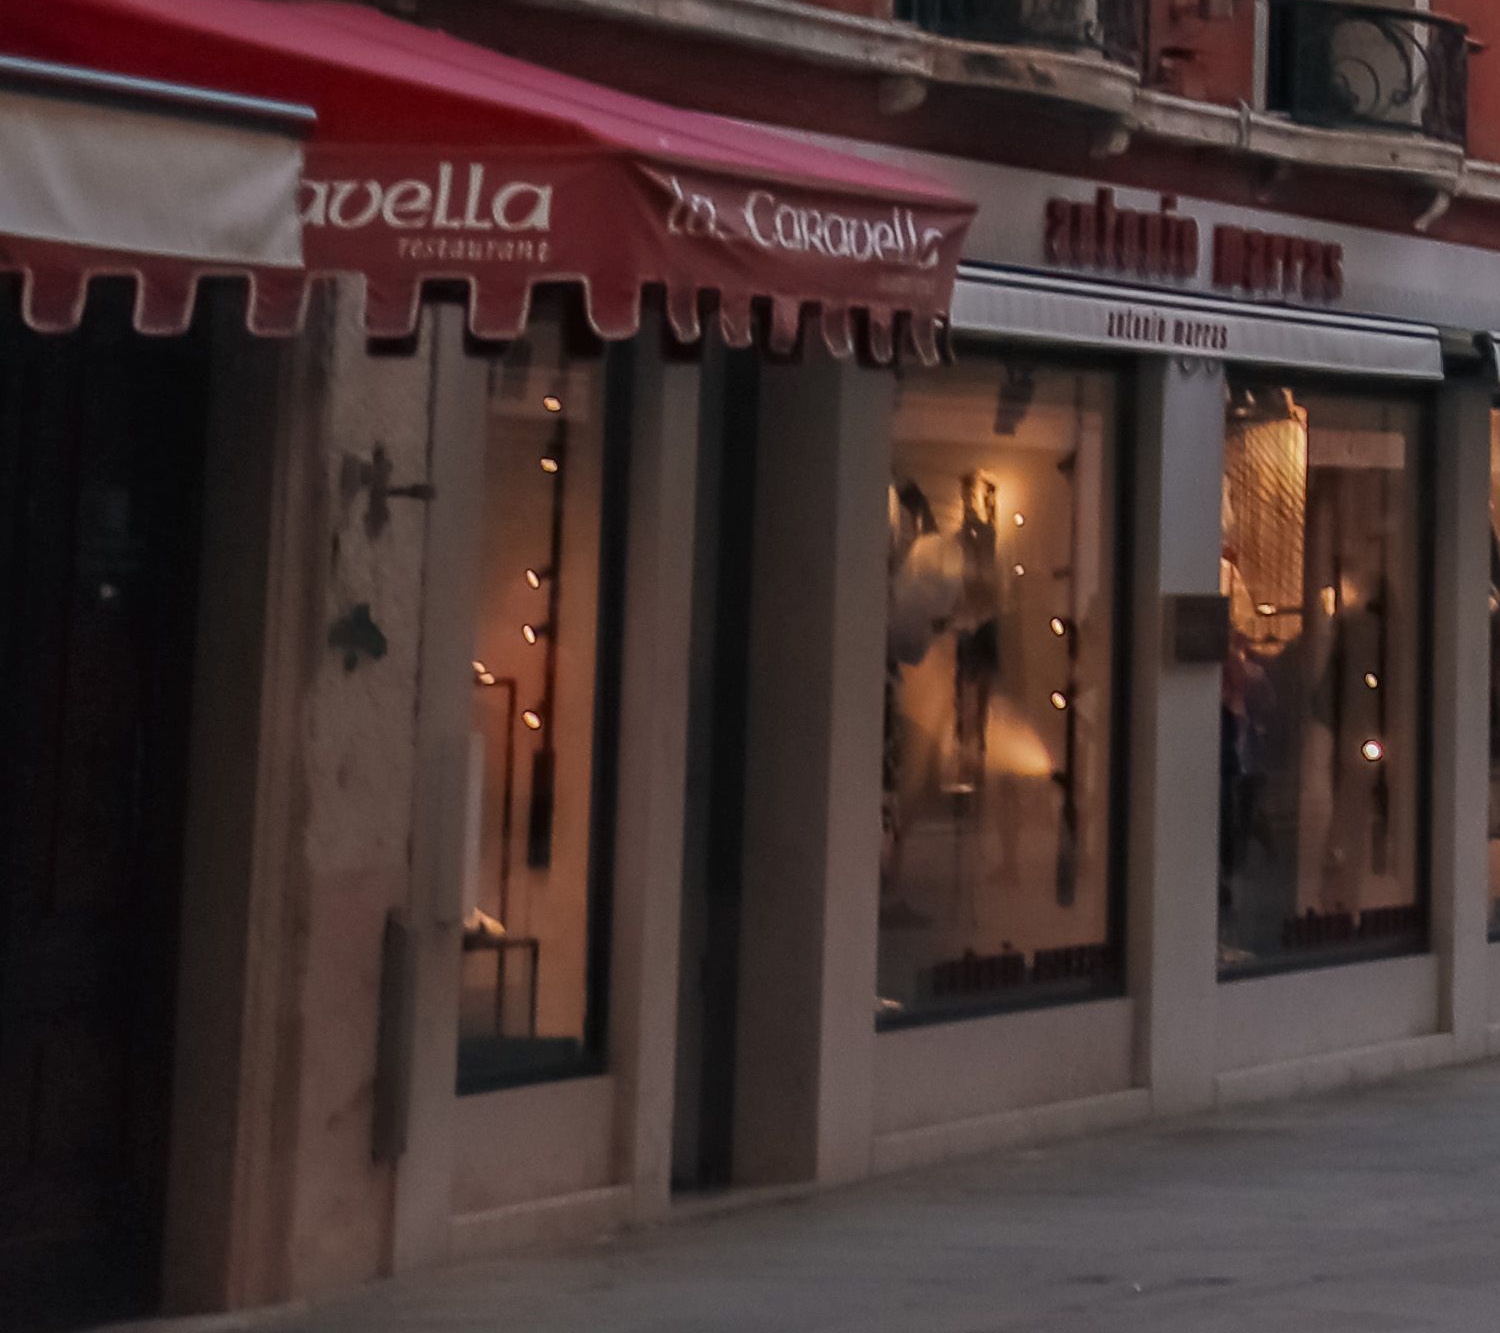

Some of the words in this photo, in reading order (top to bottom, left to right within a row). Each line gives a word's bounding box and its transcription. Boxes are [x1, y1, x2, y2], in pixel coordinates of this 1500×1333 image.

[1045, 188, 1200, 277] antonio
[1212, 224, 1344, 301] marras
[1107, 311, 1166, 344] antonio
[1174, 319, 1228, 349] marras
